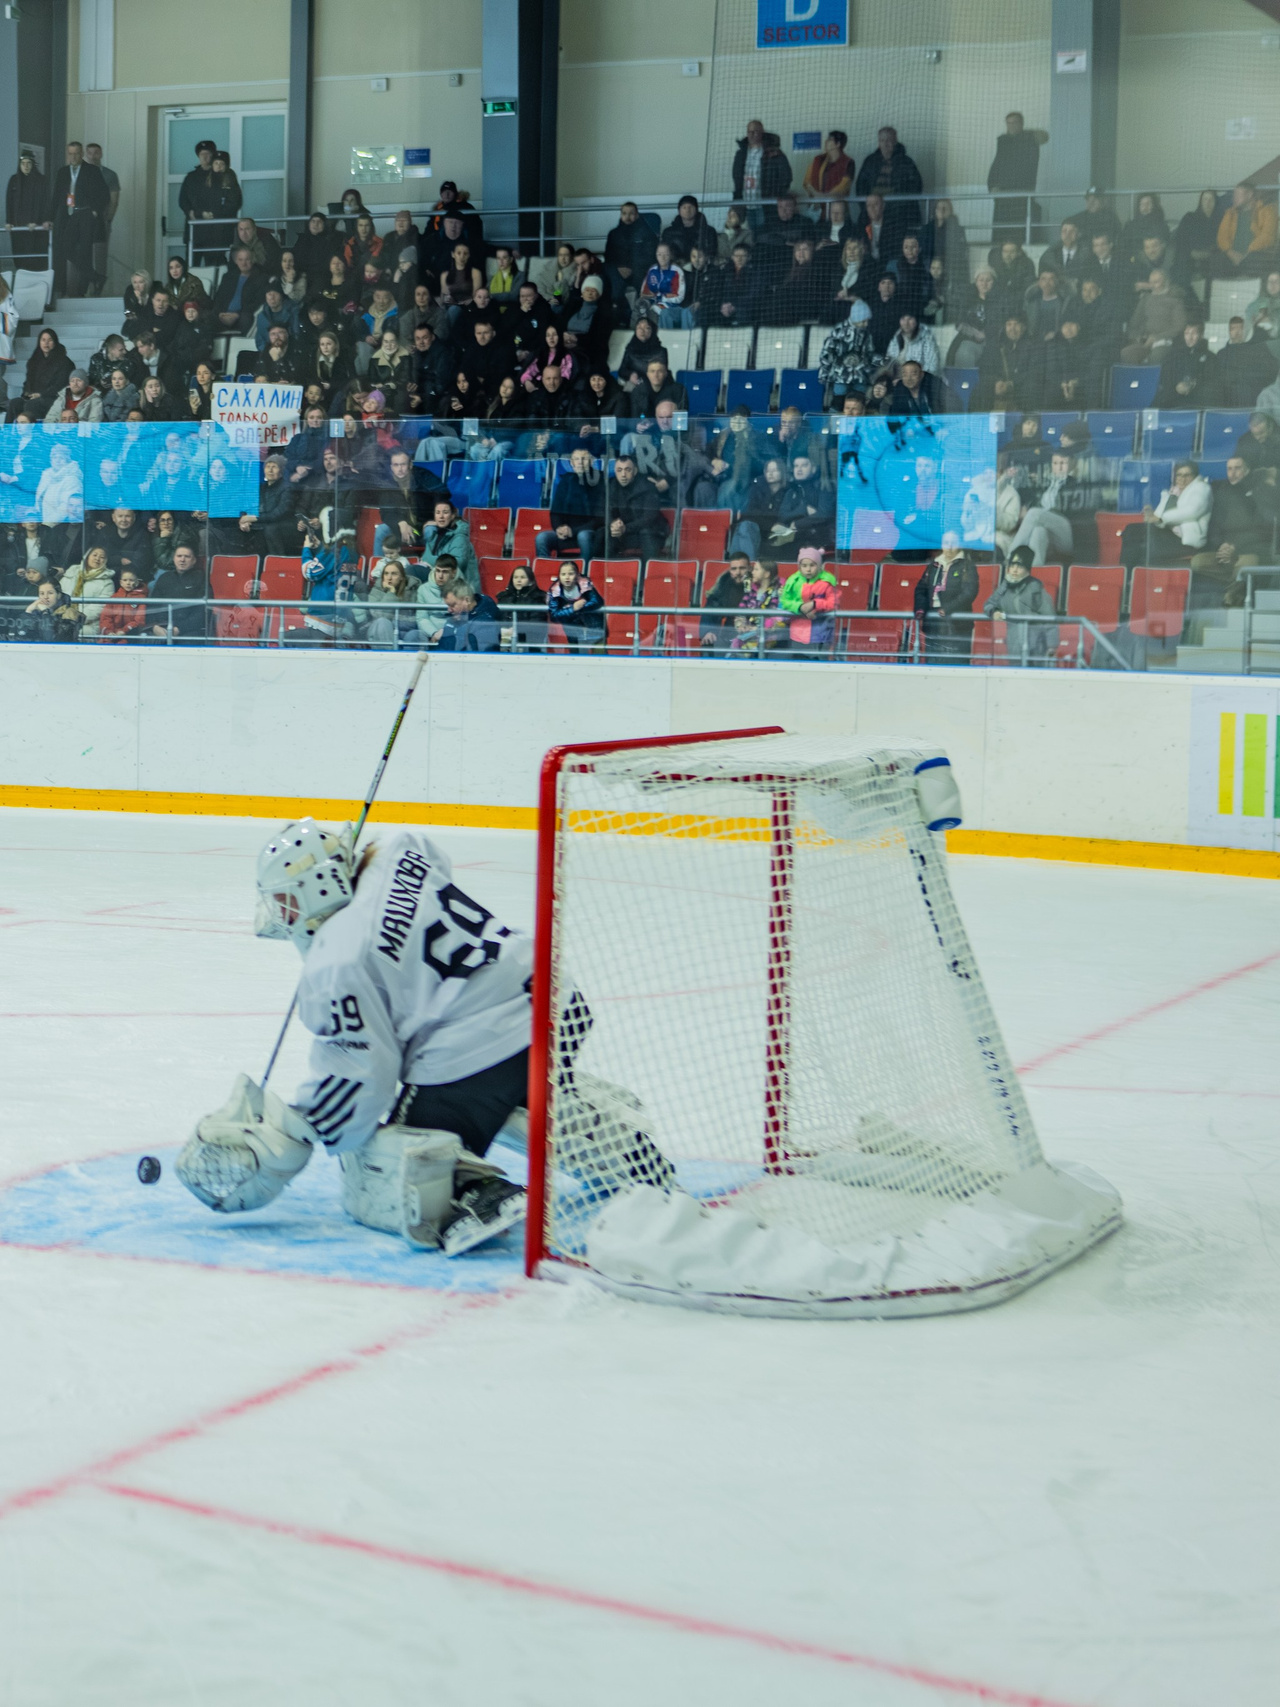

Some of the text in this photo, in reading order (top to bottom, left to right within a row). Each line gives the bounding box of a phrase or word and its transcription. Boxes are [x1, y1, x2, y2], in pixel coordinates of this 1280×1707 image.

[763, 23, 840, 43] SECTOR
[217, 388, 301, 409] САХАЛИН
[219, 411, 269, 424] ТОЛЬКО
